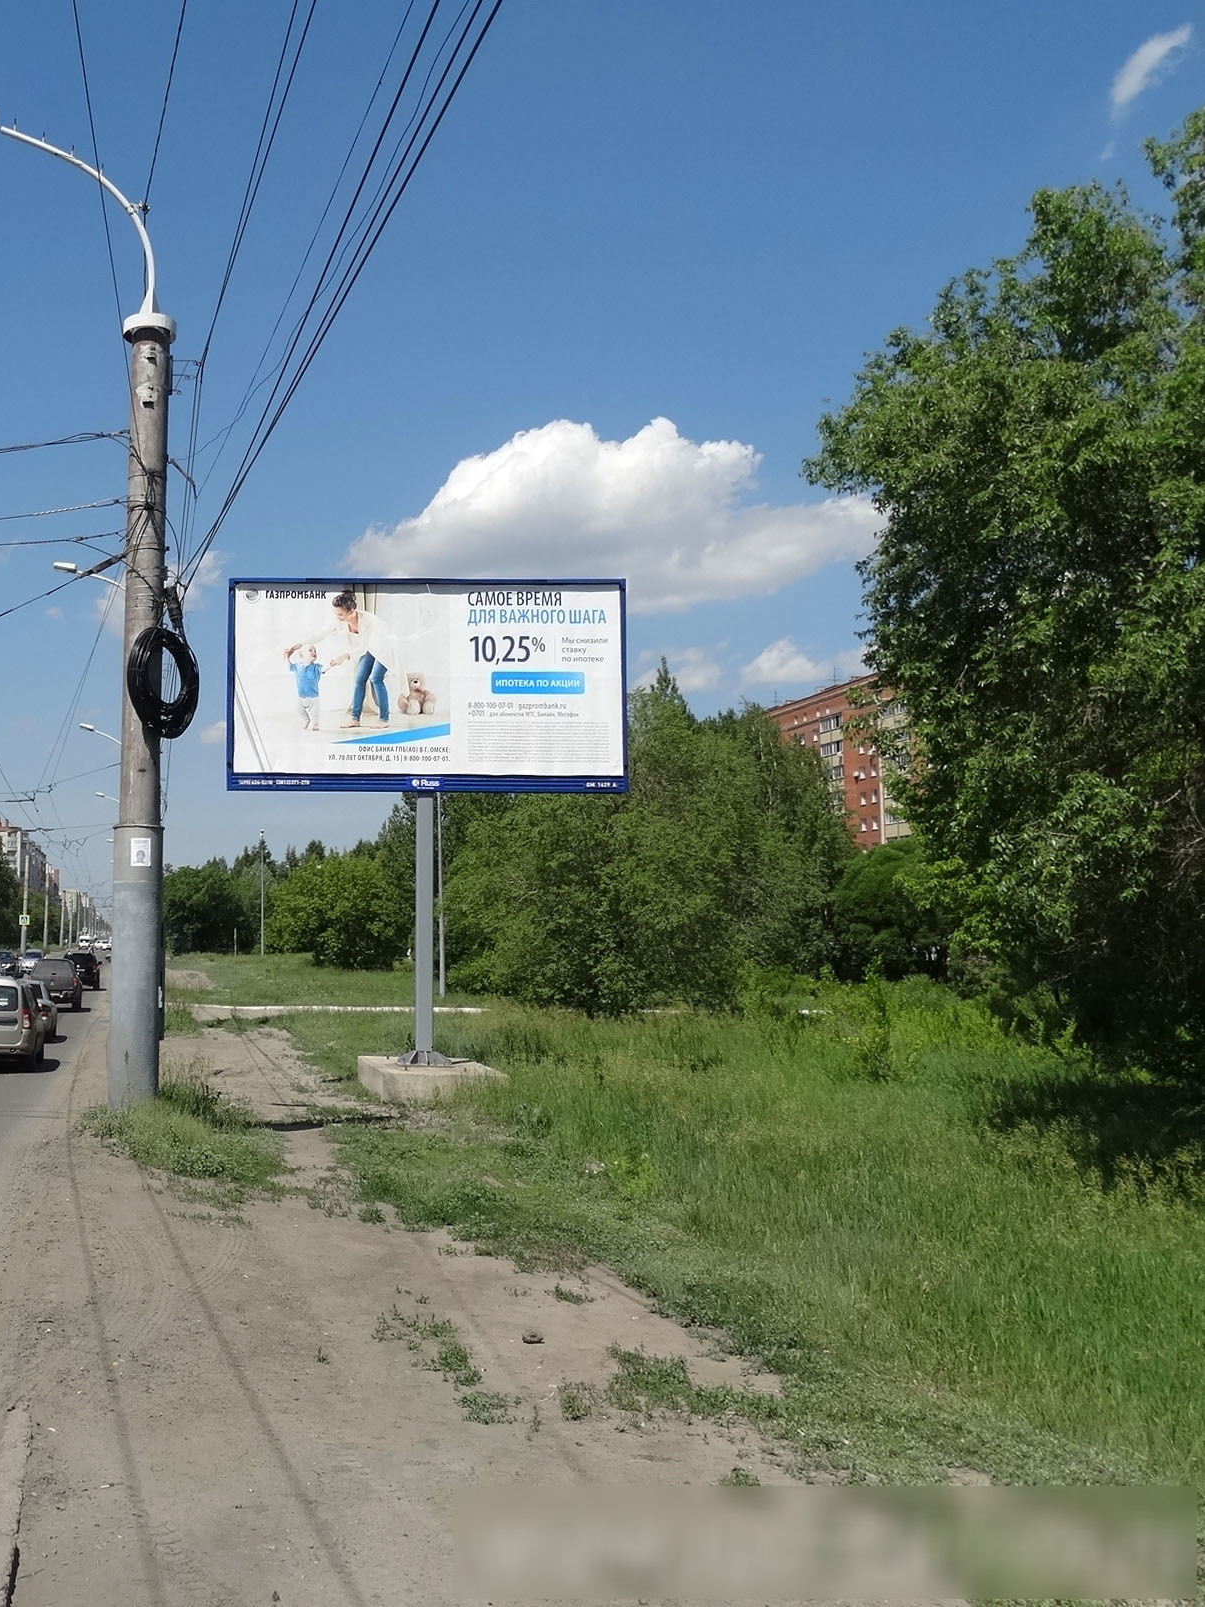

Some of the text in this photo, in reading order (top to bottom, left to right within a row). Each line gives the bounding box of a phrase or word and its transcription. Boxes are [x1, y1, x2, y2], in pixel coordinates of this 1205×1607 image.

[265, 590, 327, 600] ГАЗПРОМБАНК
[467, 591, 562, 607] САМОЕ ВРЕМЯ
[467, 609, 607, 626] ДЛЯ ВАЖНОГО ШАГА
[469, 635, 546, 665] 10,25%
[561, 647, 587, 655] ставку
[495, 679, 580, 689] ИПОТЕКА ПО АКЦИИ
[517, 701, 568, 711] gazprombank.ru
[420, 779, 440, 787] Russ
